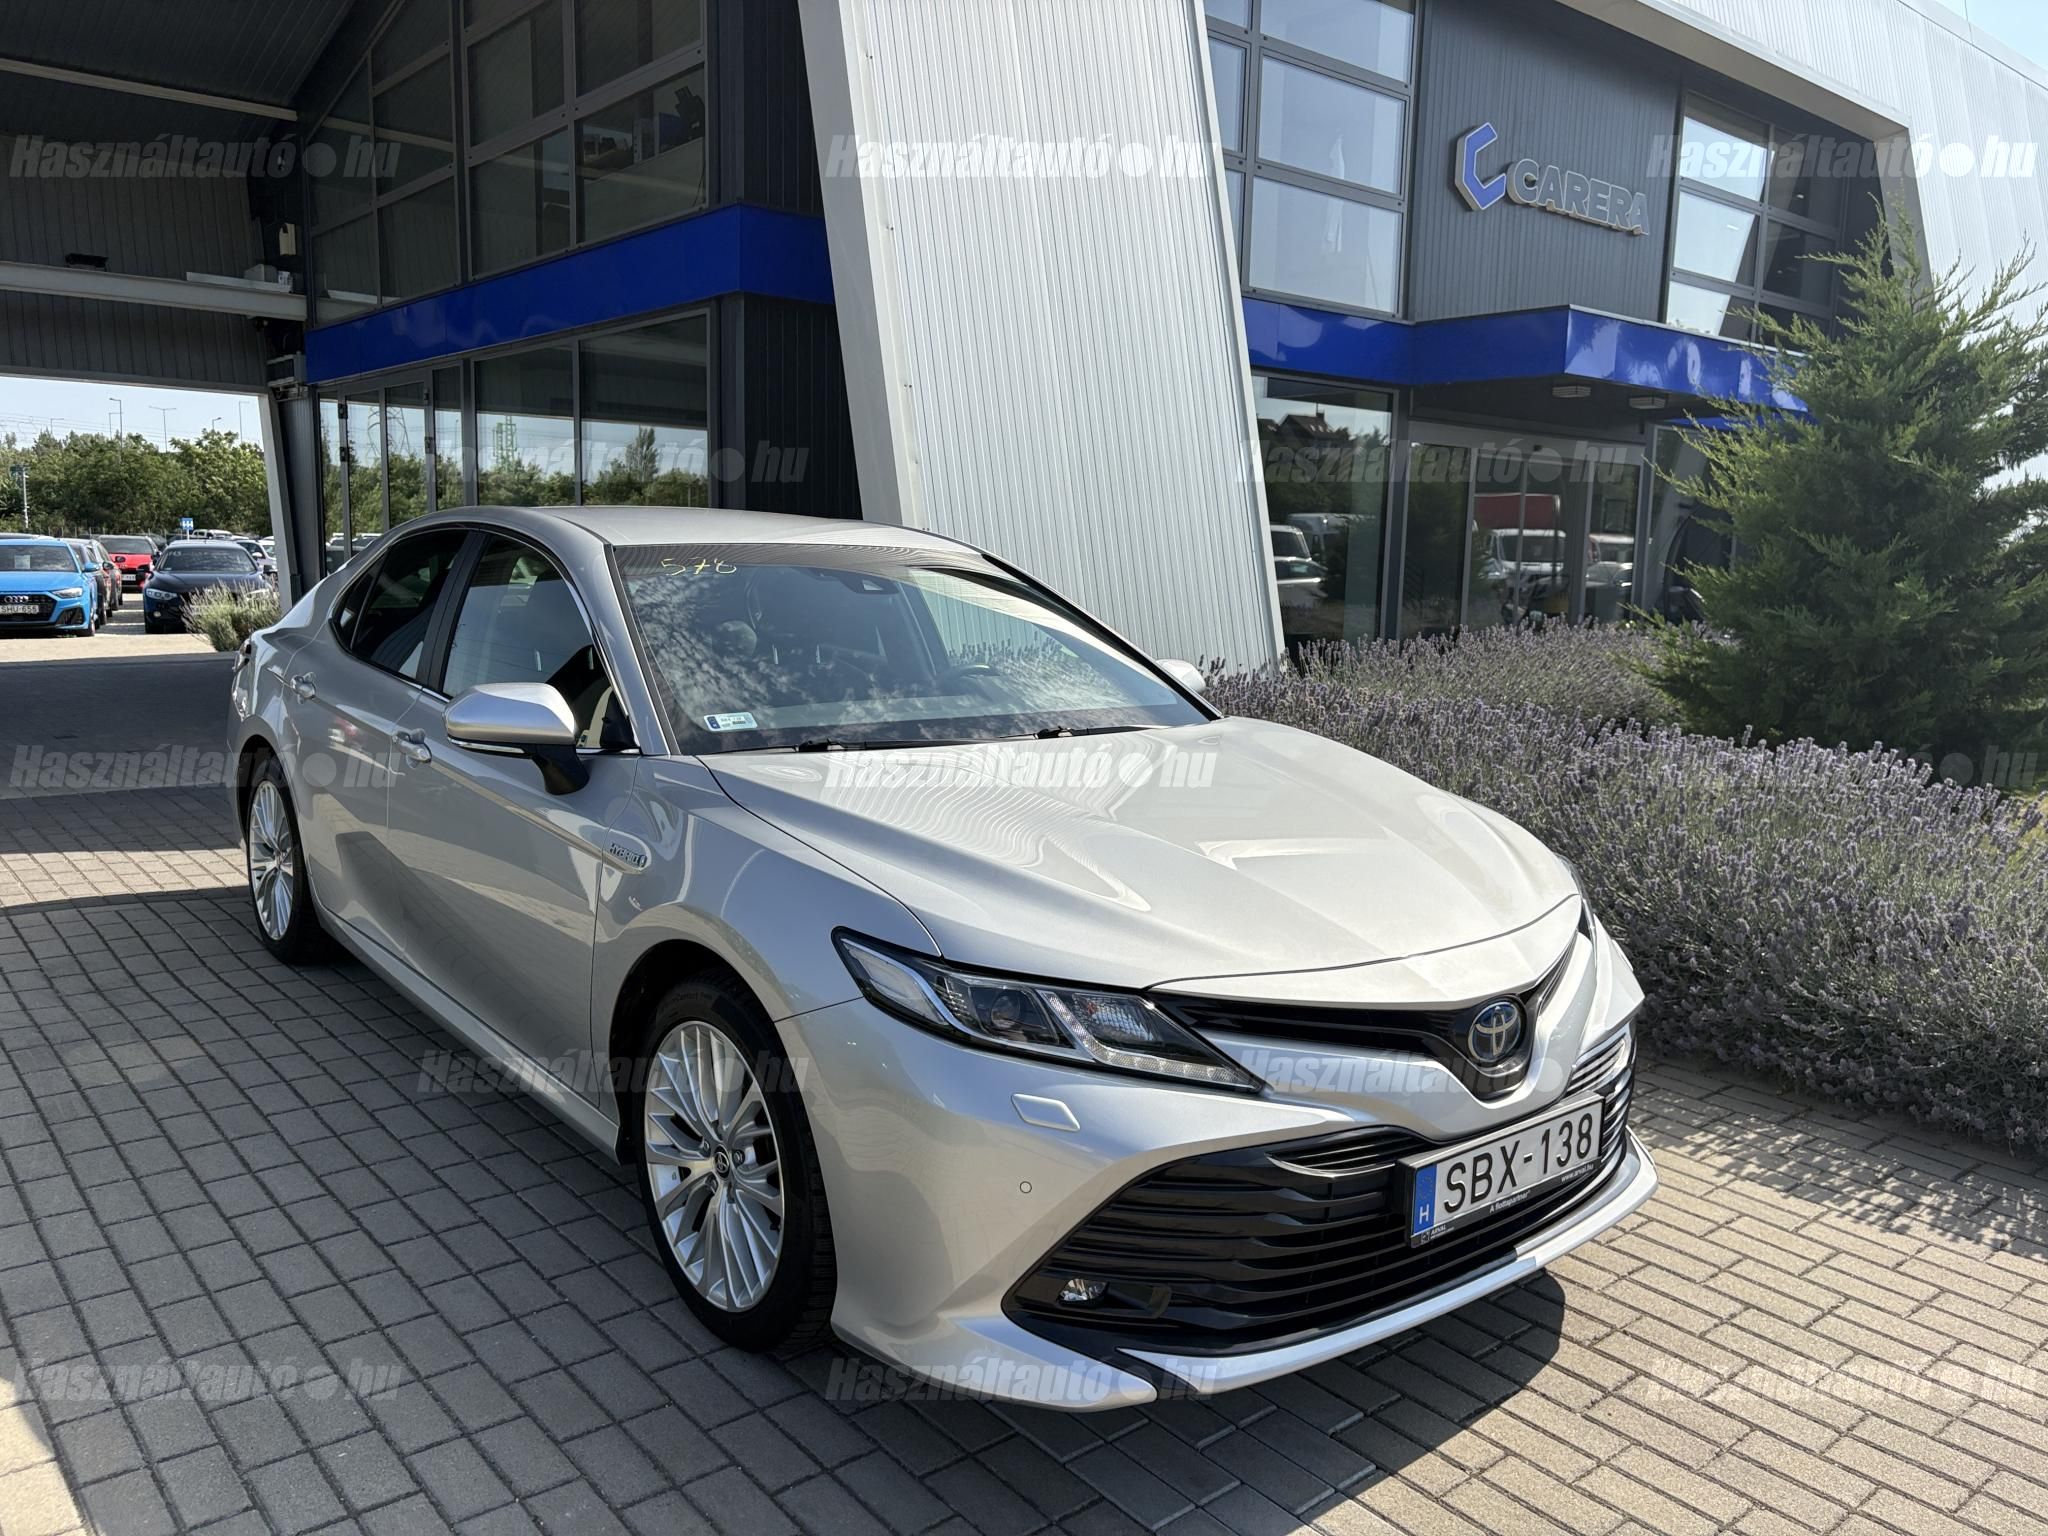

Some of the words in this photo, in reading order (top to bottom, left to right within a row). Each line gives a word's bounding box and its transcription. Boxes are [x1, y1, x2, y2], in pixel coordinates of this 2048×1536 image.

[1508, 158, 1649, 235] CARERA
[1443, 1112, 1593, 1214] SBX-138
[1419, 1203, 1430, 1225] H
